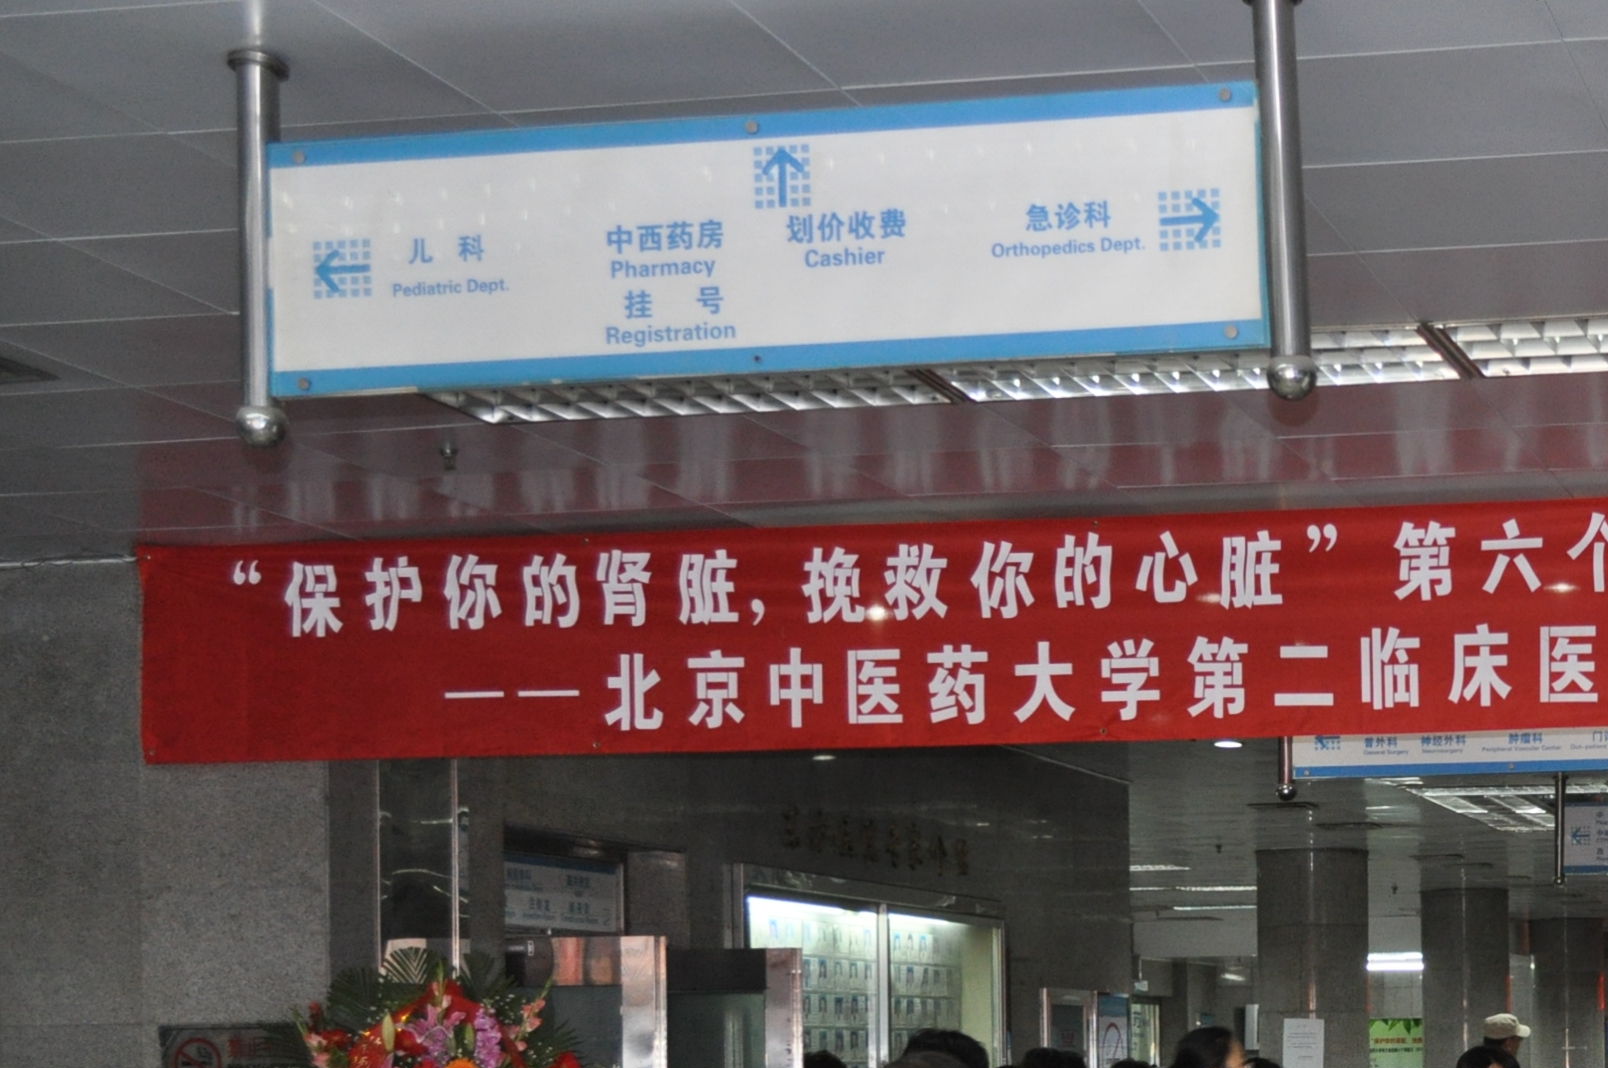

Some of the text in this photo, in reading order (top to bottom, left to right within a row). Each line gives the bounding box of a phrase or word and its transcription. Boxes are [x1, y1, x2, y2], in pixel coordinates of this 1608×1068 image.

[786, 208, 906, 244] 划价收费
[1025, 200, 1112, 232] 急诊科
[606, 219, 724, 255] 中西药房
[991, 235, 1146, 259] Orthopedics Dept.
[610, 257, 716, 280] Pharmacy
[804, 247, 885, 269] Cashier
[392, 277, 510, 298] Pediatric Dept.
[606, 322, 737, 349] Registration
